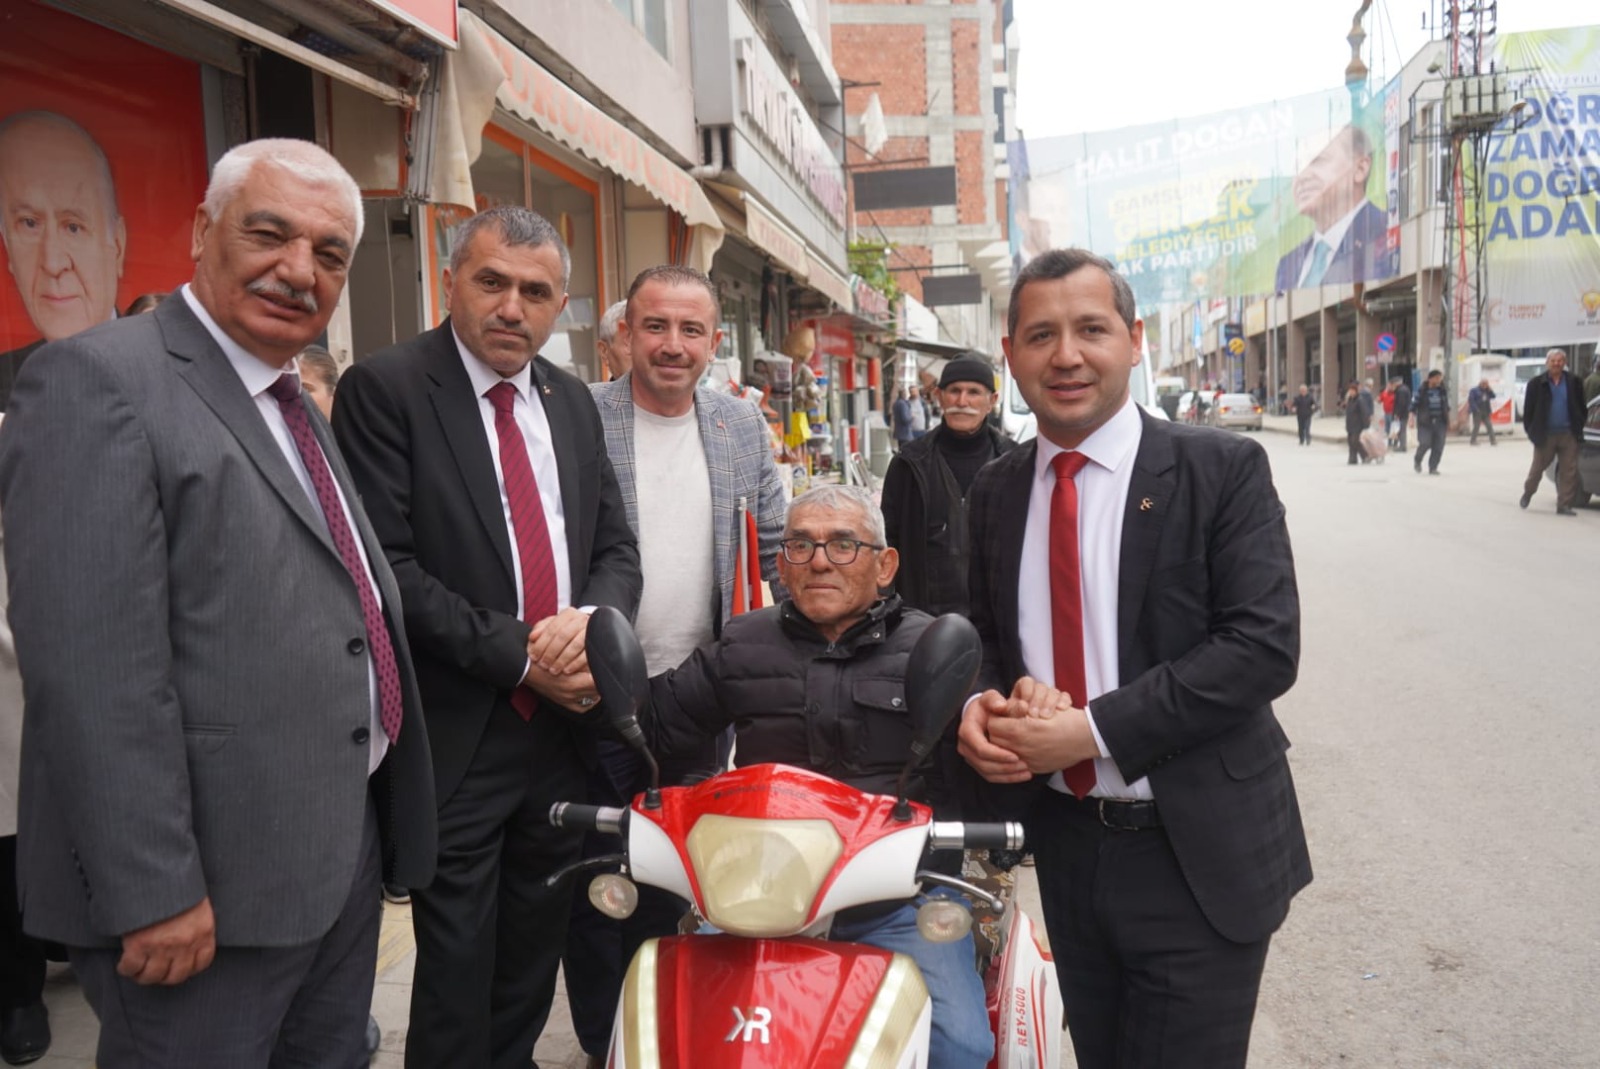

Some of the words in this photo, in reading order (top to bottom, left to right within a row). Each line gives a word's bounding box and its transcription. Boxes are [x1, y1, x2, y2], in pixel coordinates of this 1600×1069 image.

[1487, 199, 1600, 243] ADA
[1117, 259, 1144, 277] AK
[1015, 986, 1028, 1047] REY-5000
